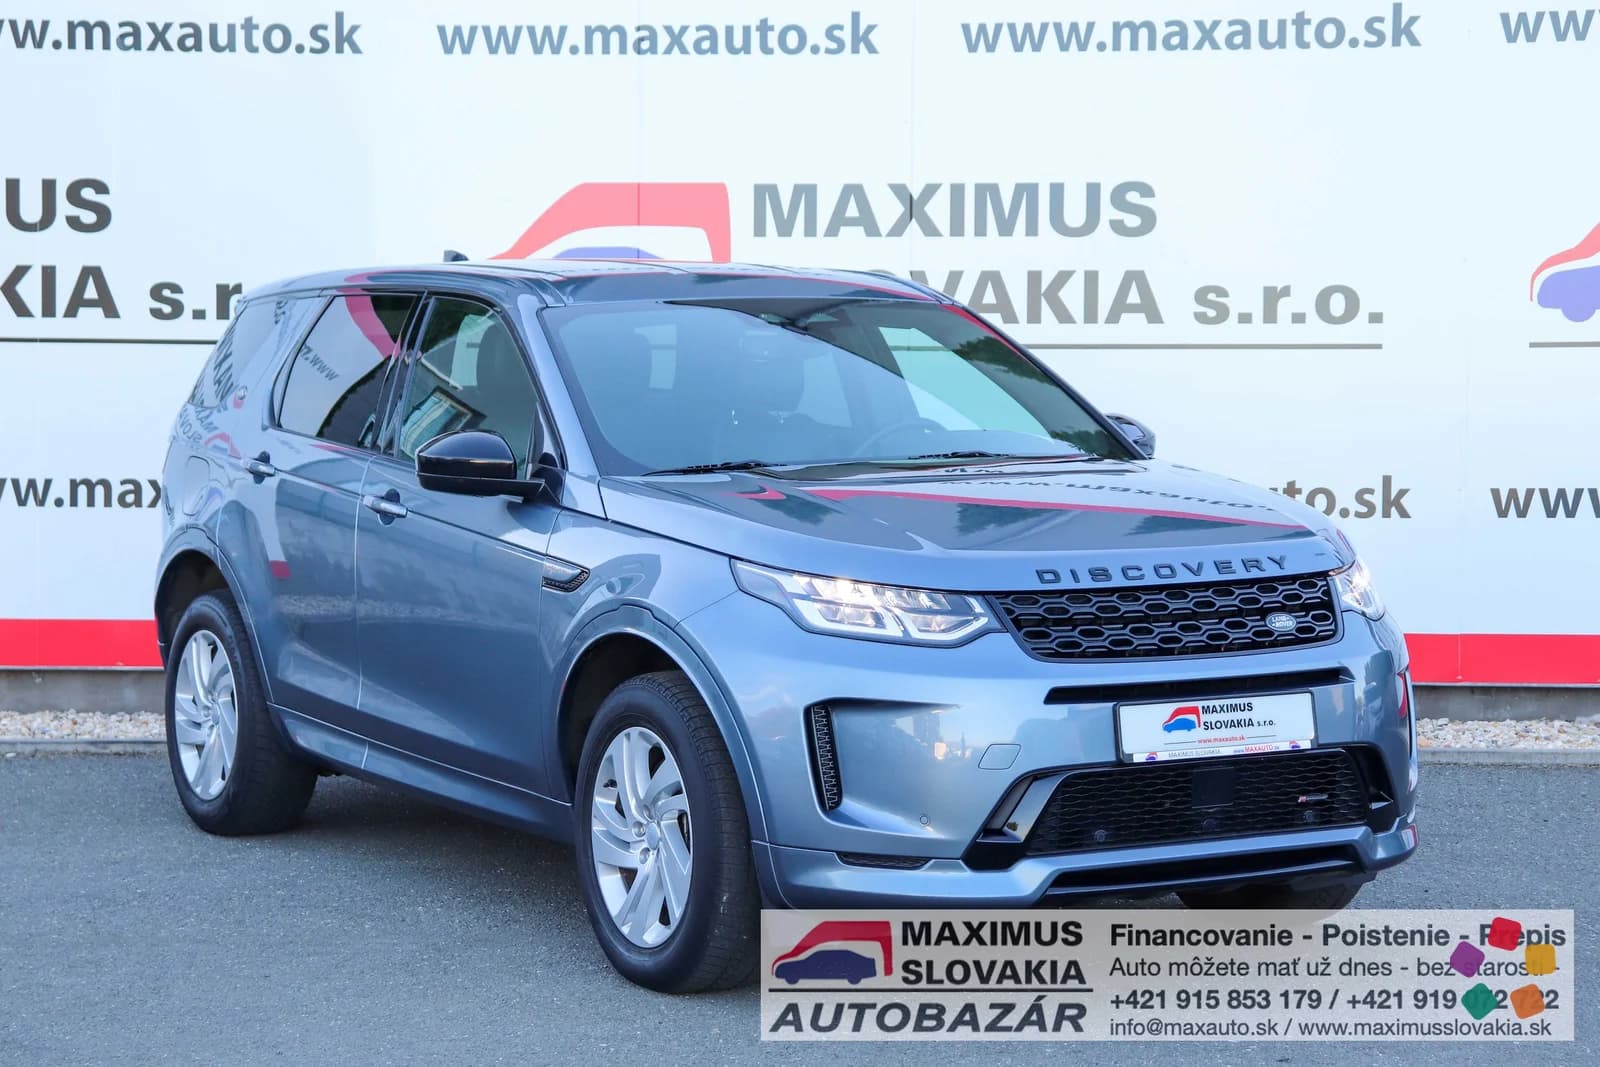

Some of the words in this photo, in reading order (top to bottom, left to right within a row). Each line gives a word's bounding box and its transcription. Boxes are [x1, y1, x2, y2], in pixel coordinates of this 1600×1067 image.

[0, 12, 362, 54] w.maxauto.sk
[437, 11, 878, 55] www.maxauto.sk
[961, 3, 1421, 53] www.maxauto.sk
[1500, 10, 1600, 43] ww
[753, 181, 1157, 238] MAXIMUS
[1193, 285, 1384, 325] s.r.o.
[1035, 555, 1288, 585] DISCOVERY
[1201, 702, 1254, 715] MAXIMUS
[1203, 718, 1255, 730] SLOVAKIA
